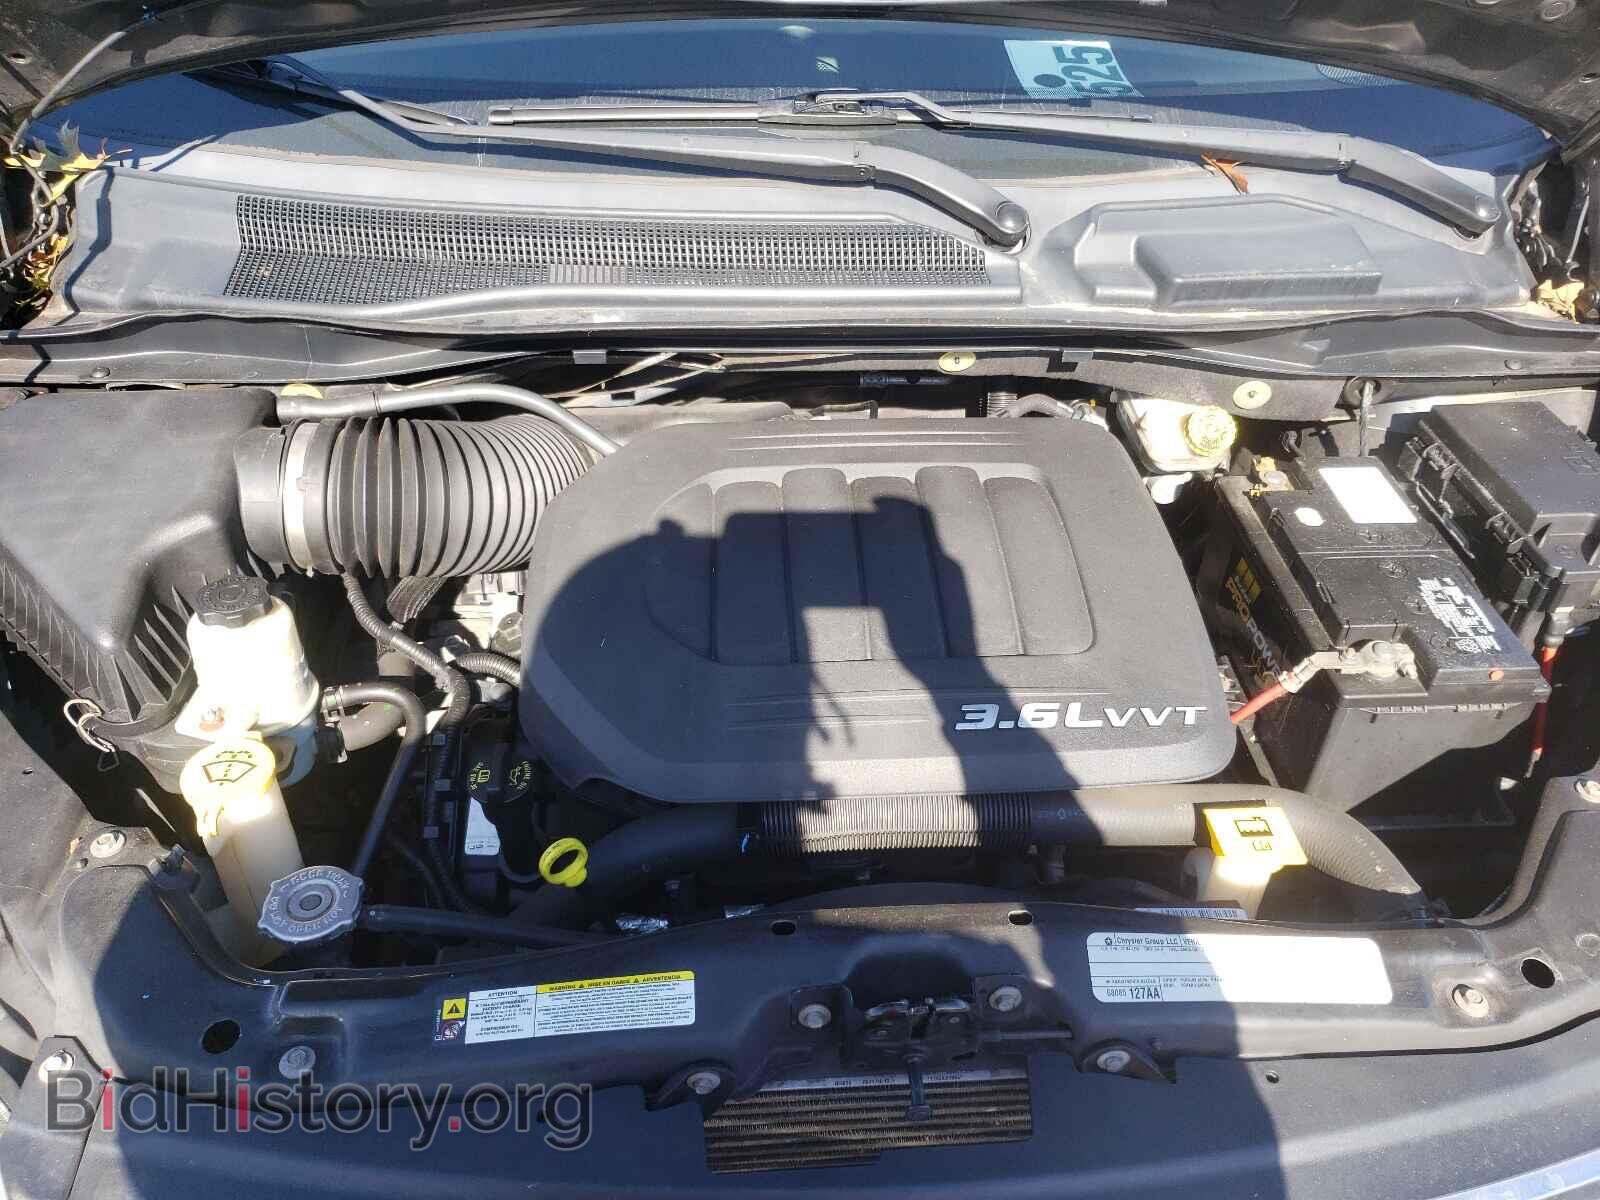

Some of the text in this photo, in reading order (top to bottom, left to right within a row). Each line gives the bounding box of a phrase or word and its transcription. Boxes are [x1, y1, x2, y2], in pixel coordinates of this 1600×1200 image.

[1117, 935, 1143, 946] Chrysler
[1144, 936, 1164, 946] Group
[1166, 936, 1178, 945] LLC
[549, 984, 576, 992] WARNING
[488, 990, 518, 998] ATTENTION
[1129, 987, 1160, 999] 127AA
